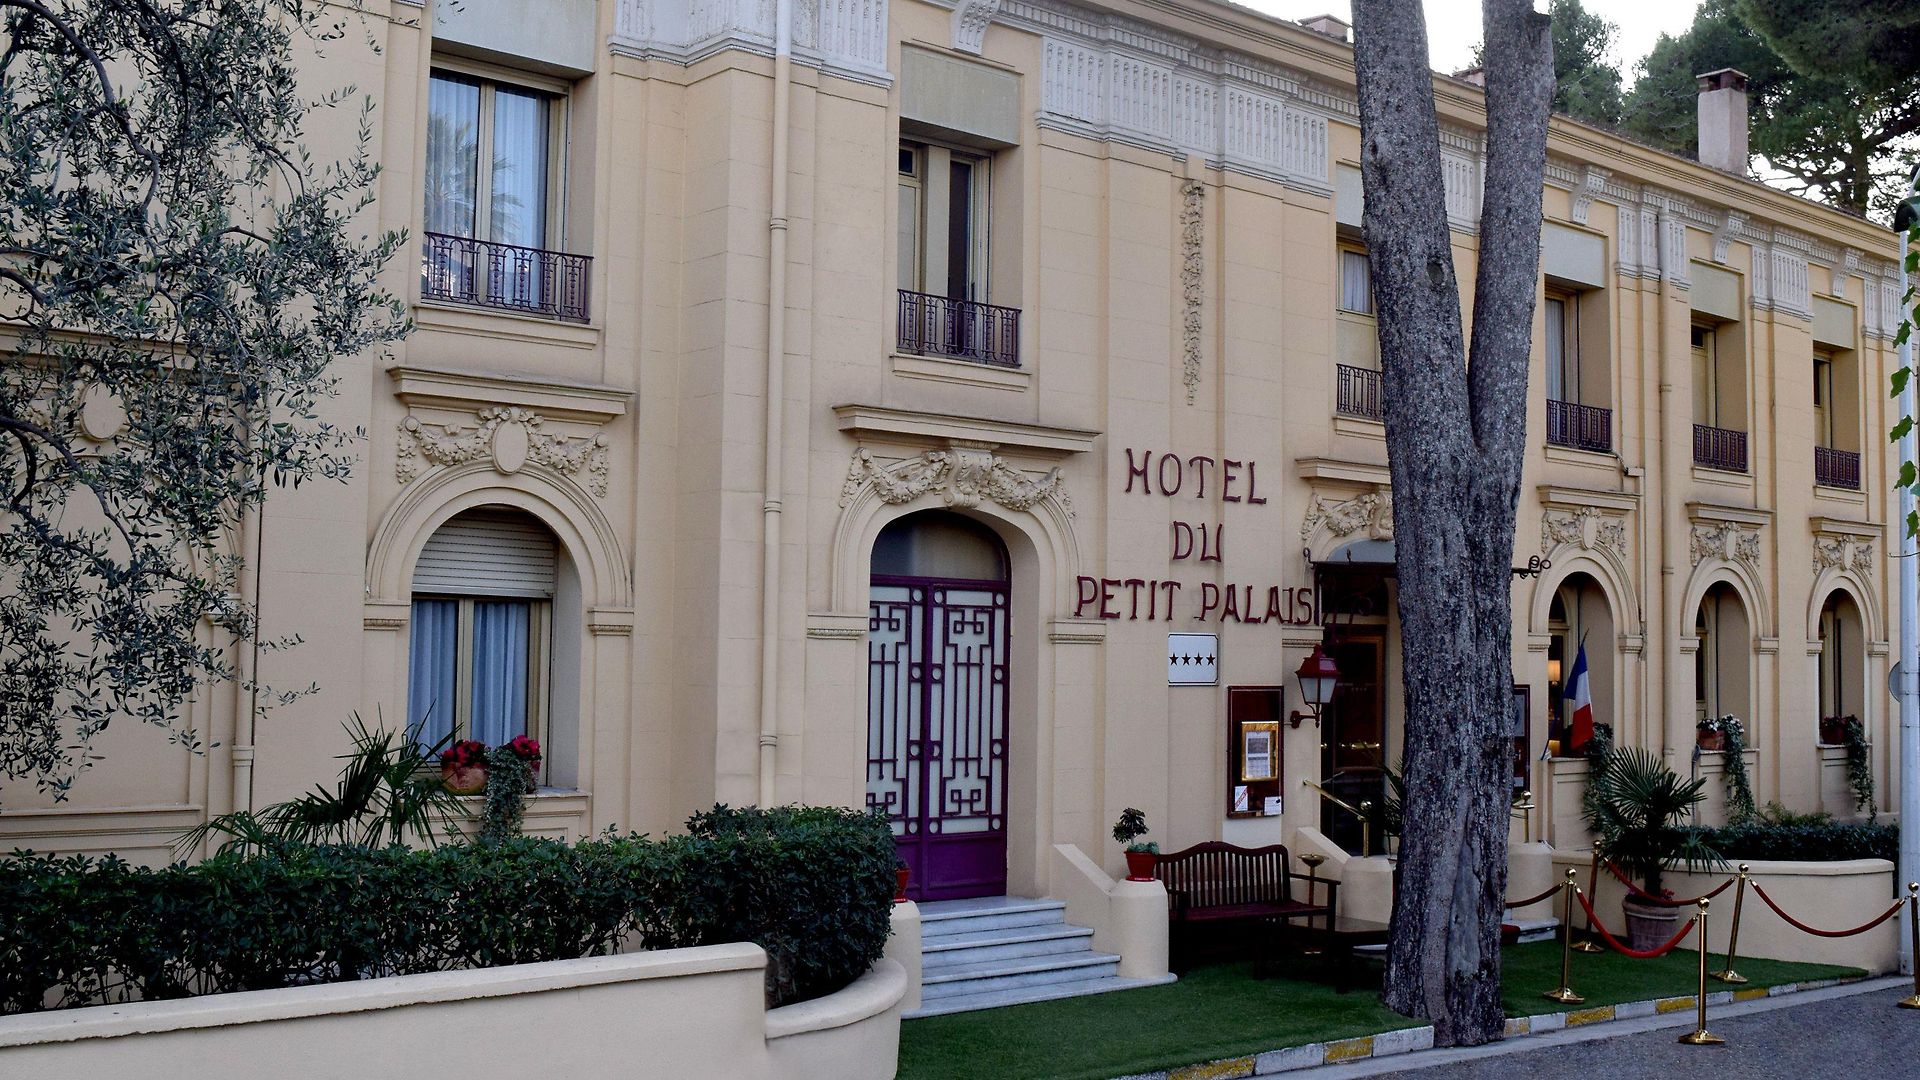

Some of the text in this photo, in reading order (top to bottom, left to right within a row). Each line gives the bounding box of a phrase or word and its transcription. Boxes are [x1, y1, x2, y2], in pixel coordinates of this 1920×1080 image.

[1125, 447, 1268, 505] HOTEL
[1172, 520, 1224, 563] DU
[1073, 574, 1314, 626] PETIT PALAIS
